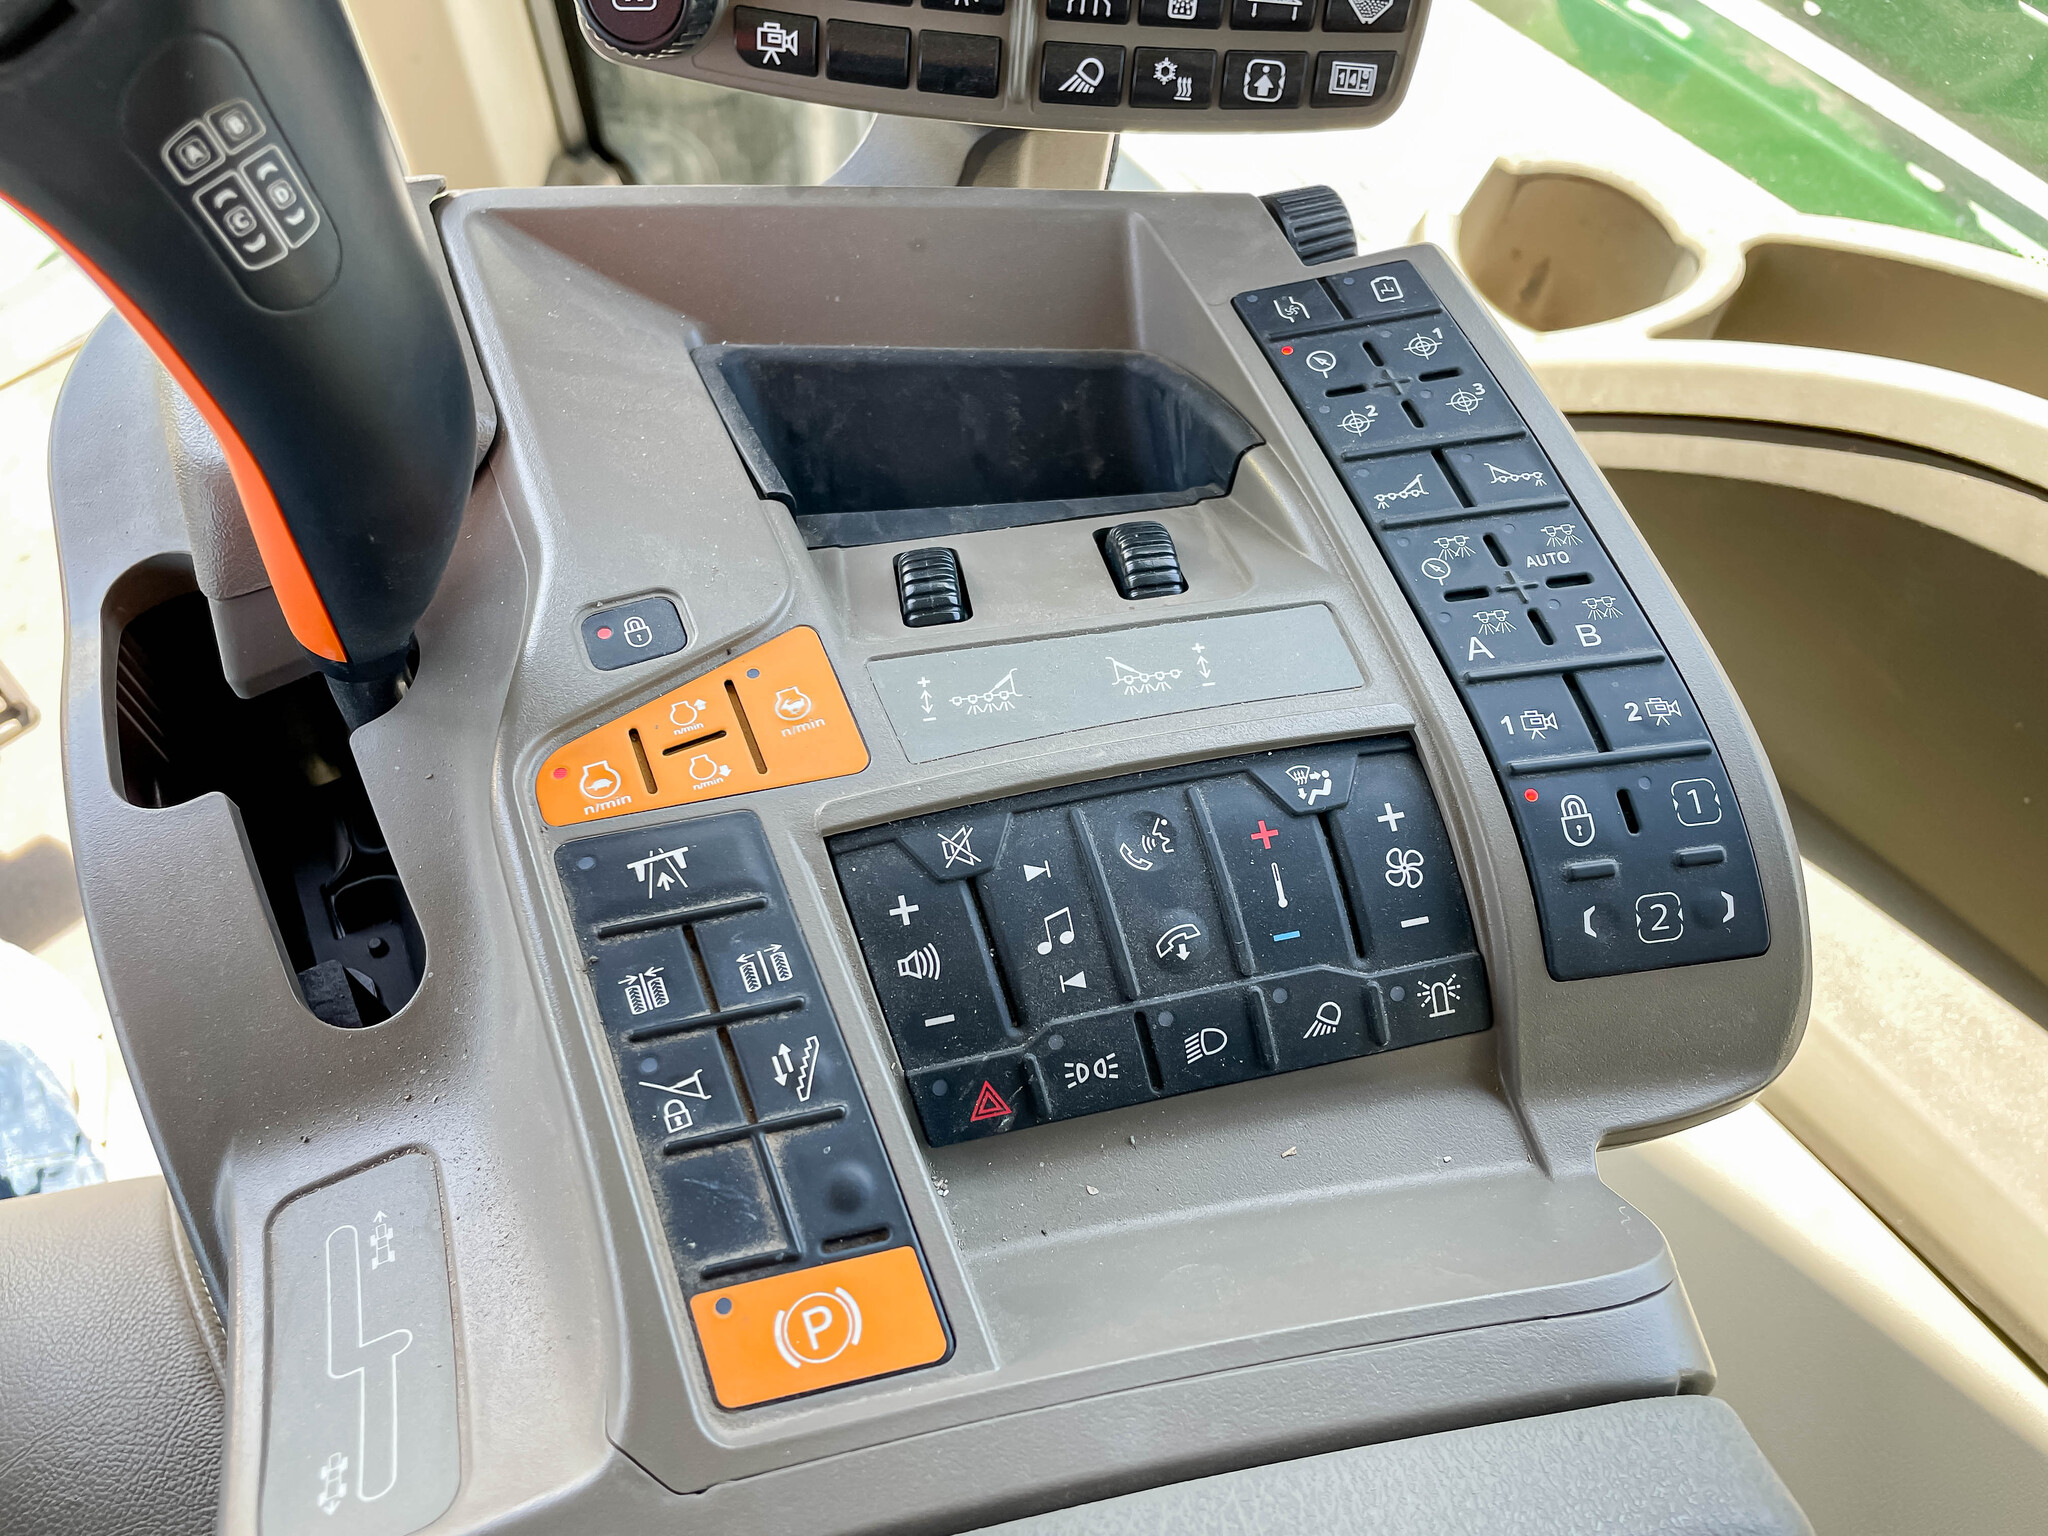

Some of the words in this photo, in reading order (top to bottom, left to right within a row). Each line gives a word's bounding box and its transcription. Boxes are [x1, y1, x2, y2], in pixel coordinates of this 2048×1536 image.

[185, 144, 204, 163] A
[1432, 327, 1443, 339] 1
[1472, 382, 1486, 395] 3
[1365, 405, 1378, 417] 2
[1526, 551, 1569, 568] AUTO
[1575, 624, 1602, 647] B
[1468, 636, 1495, 661] A
[1624, 702, 1642, 721] 2
[673, 721, 704, 735] n/min
[781, 718, 825, 737] n/min
[1501, 715, 1514, 735] 1
[693, 776, 724, 790] n/min
[584, 794, 632, 815] n/min
[1687, 789, 1702, 814] 1
[1650, 903, 1670, 931] 2
[802, 1305, 833, 1351] P
